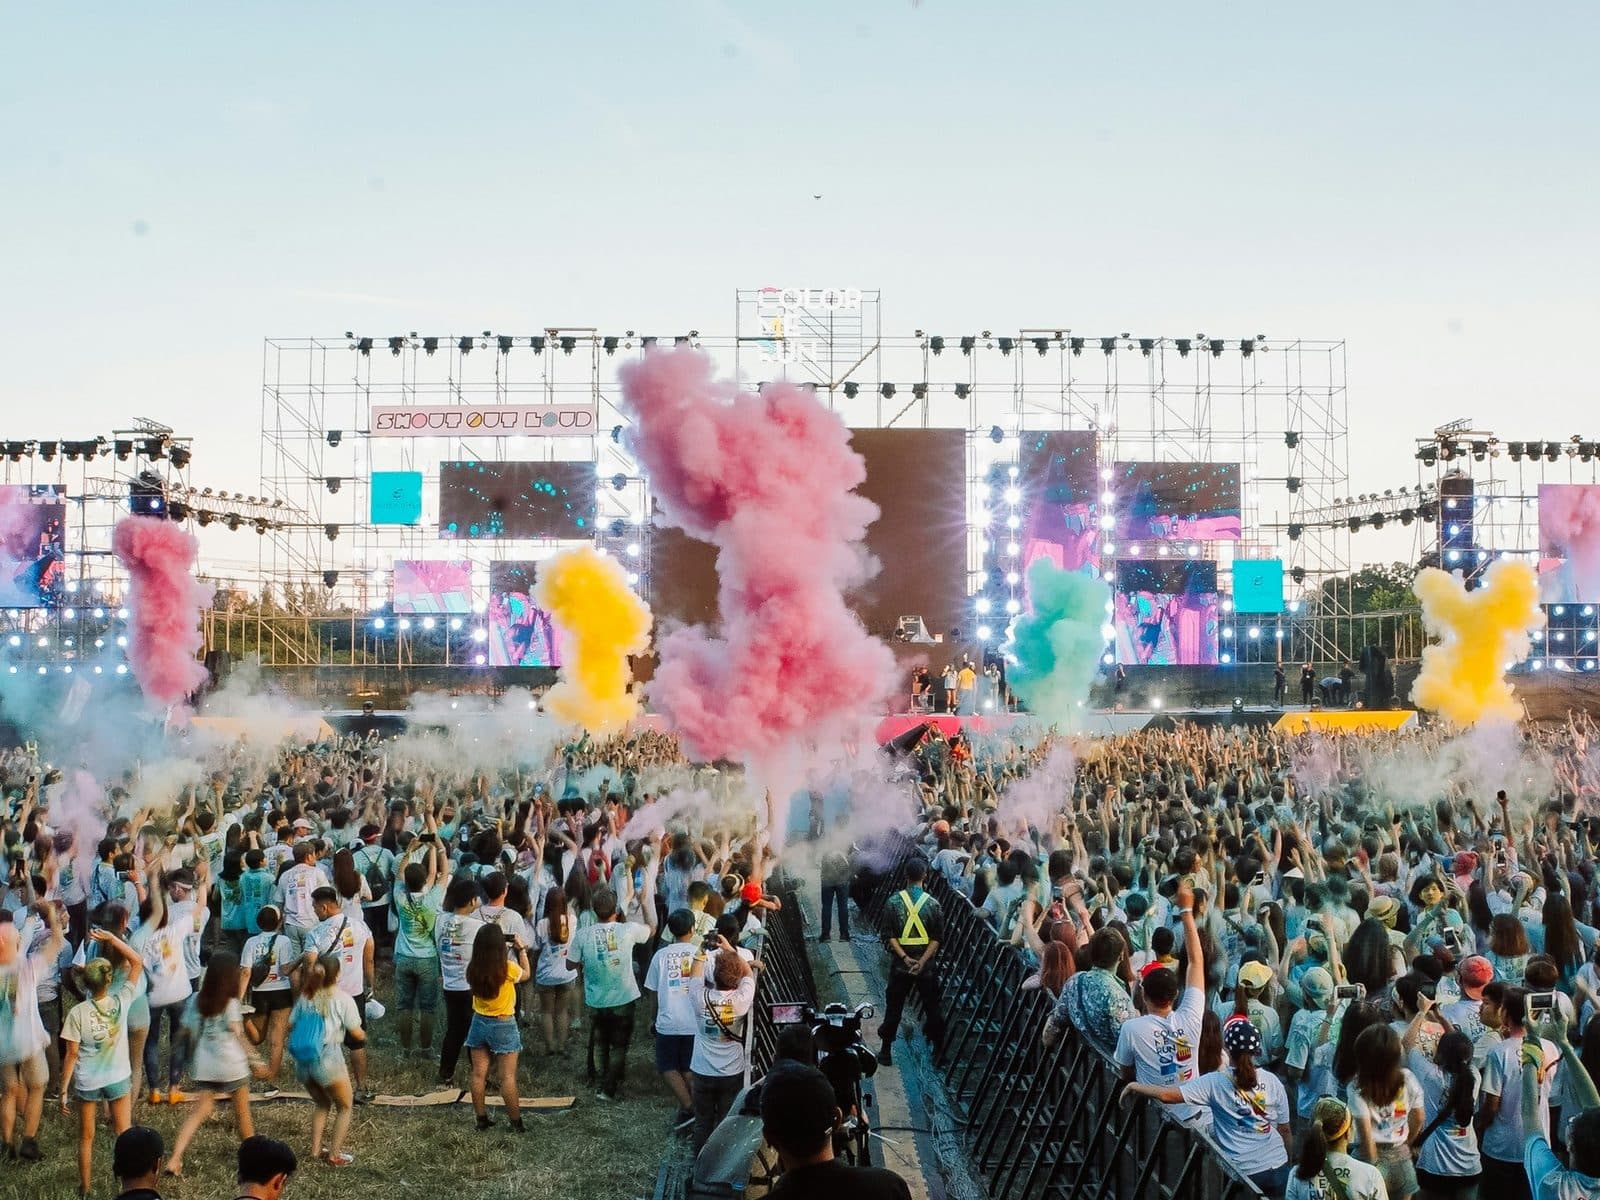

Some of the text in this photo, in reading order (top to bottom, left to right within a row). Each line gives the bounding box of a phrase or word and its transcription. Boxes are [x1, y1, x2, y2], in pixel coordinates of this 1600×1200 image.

[757, 286, 864, 309] COLOR
[377, 411, 593, 429] SHOUT OUT LOUD
